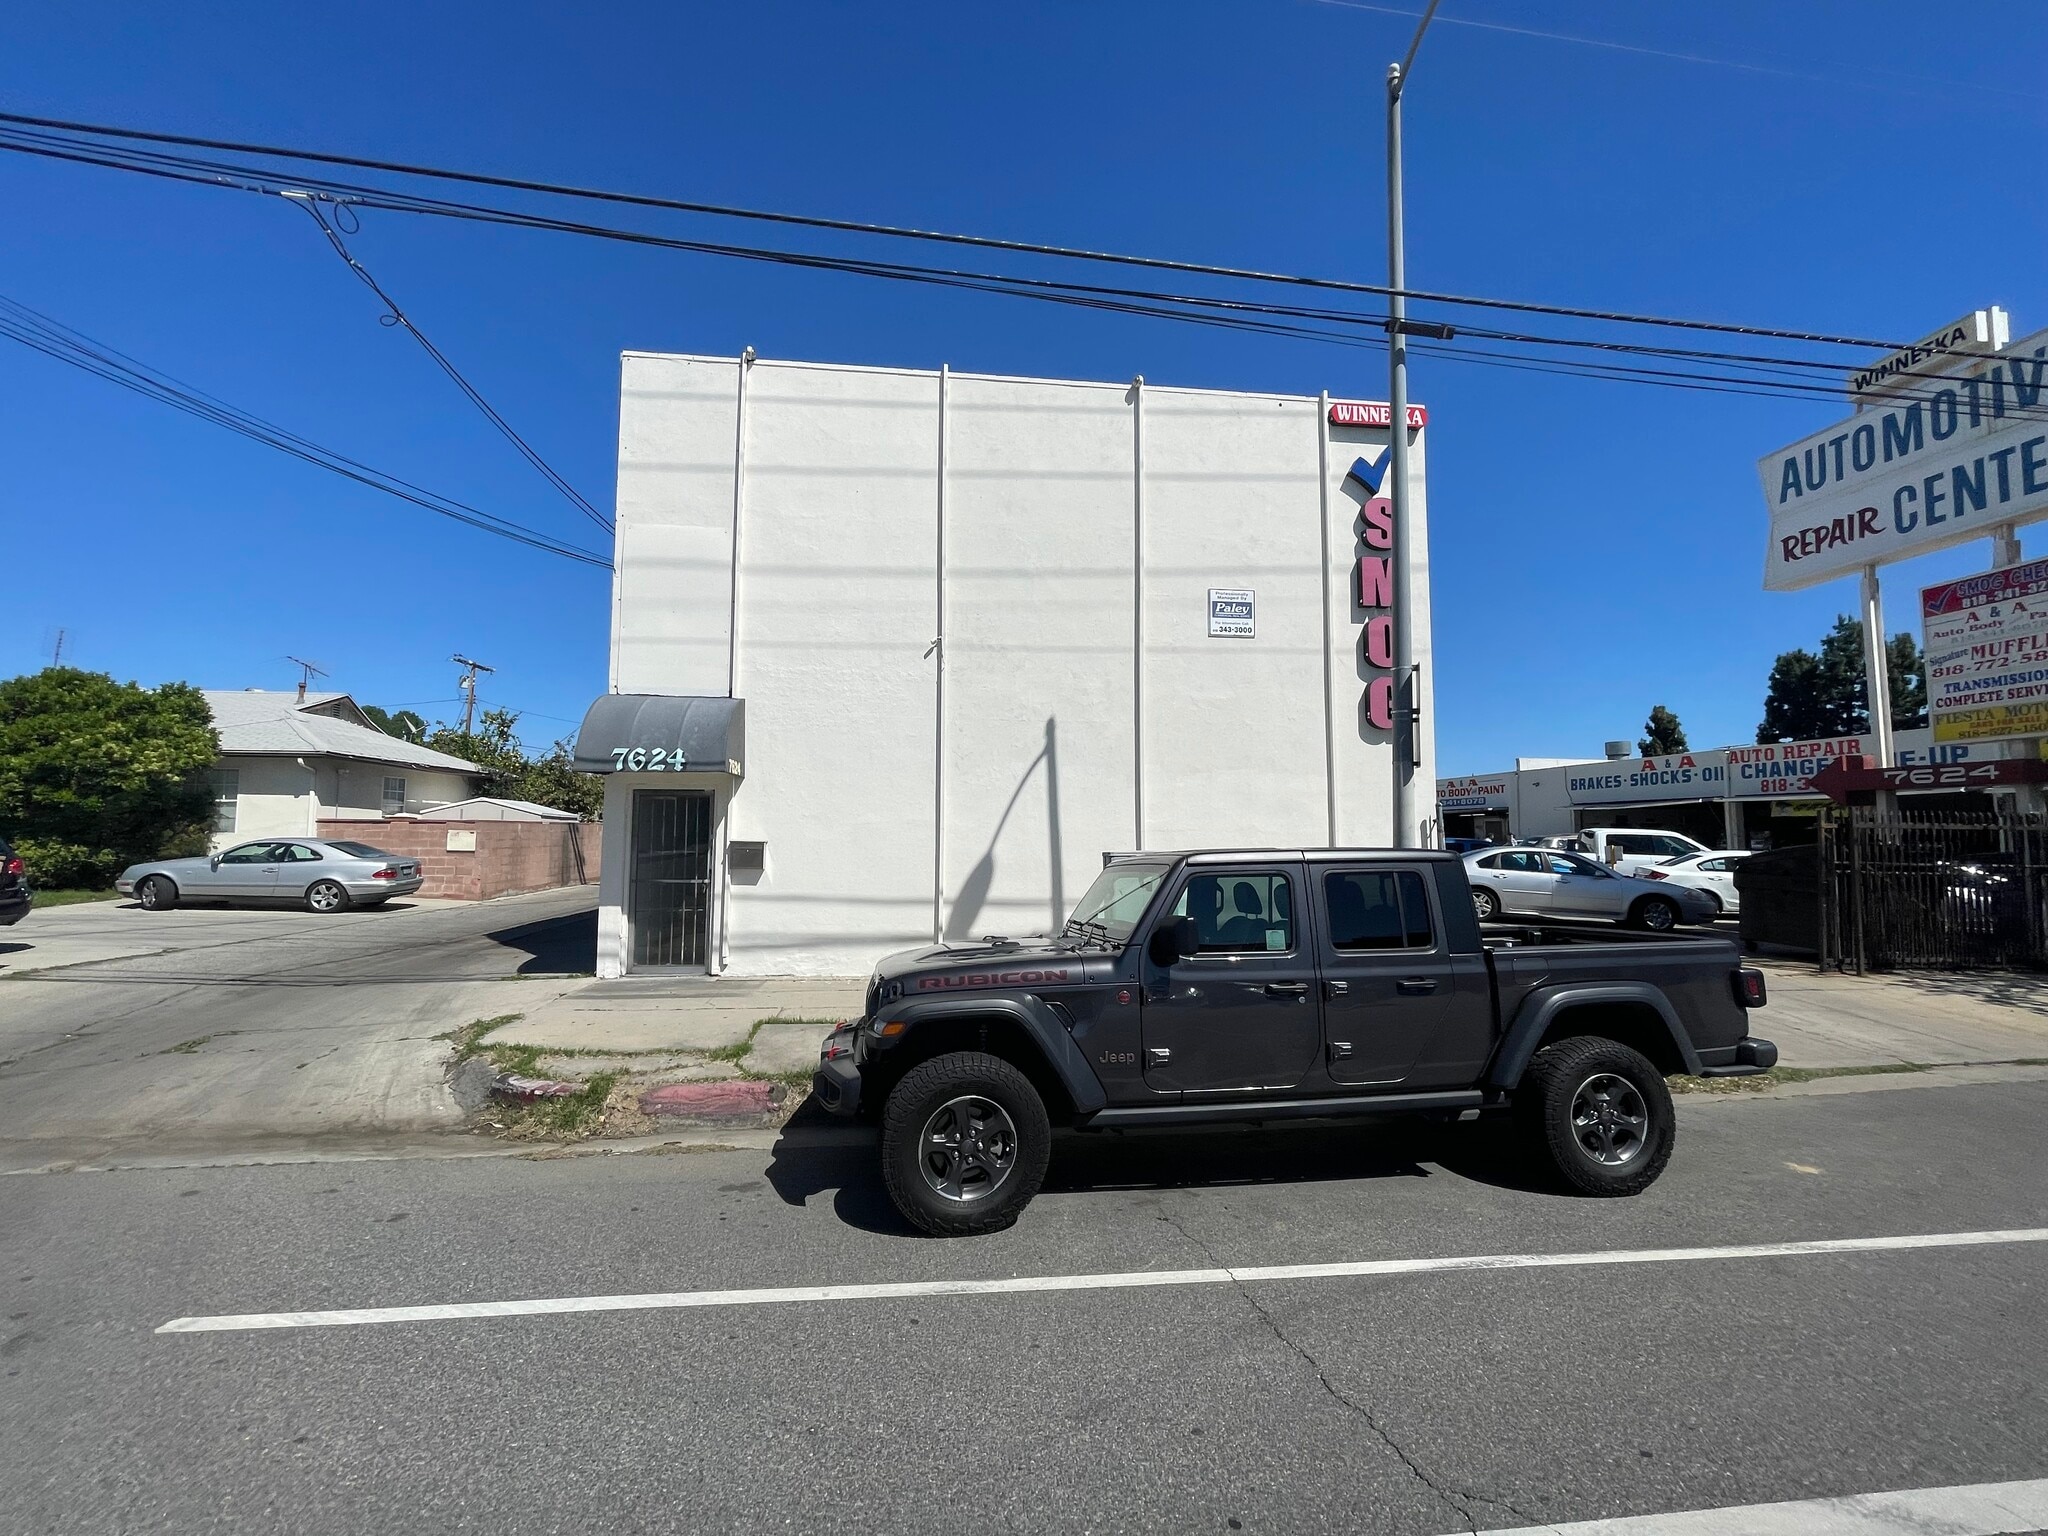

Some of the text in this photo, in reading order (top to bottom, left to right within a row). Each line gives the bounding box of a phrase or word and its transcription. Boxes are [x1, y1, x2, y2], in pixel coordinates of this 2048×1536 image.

[1854, 327, 1967, 390] WINNETKA
[1336, 404, 1424, 425] WINNEKA
[1779, 346, 2047, 504] AUTOMOTIV
[1893, 435, 2048, 534] CENTE
[1780, 506, 1886, 562] REPAIR
[1956, 574, 2005, 597] SMOG
[1215, 602, 1250, 615] Paley
[1965, 601, 2028, 624] A & A
[1219, 626, 1252, 634] 343-3000
[1933, 628, 1964, 639] Auto
[1969, 620, 2005, 632] Body
[1929, 648, 1969, 667] Signature
[1931, 650, 2048, 678] 818-772-58
[1935, 690, 2004, 708] COMPLETE
[1935, 707, 1995, 725] FIESTA
[610, 747, 686, 772] 7624
[1728, 739, 1861, 764] AUTO REPAIR
[729, 758, 741, 776] 7624
[1640, 756, 1697, 771] A & A
[1570, 775, 1622, 791] BRAKES
[1630, 769, 1692, 787] SHOCKS
[1884, 764, 2000, 784] 7624
[1446, 781, 1456, 789] A
[1448, 788, 1472, 797] BODY
[1478, 785, 1506, 795] PAINT
[919, 969, 1068, 989] RUBICON
[1099, 1051, 1135, 1065] Jeep
